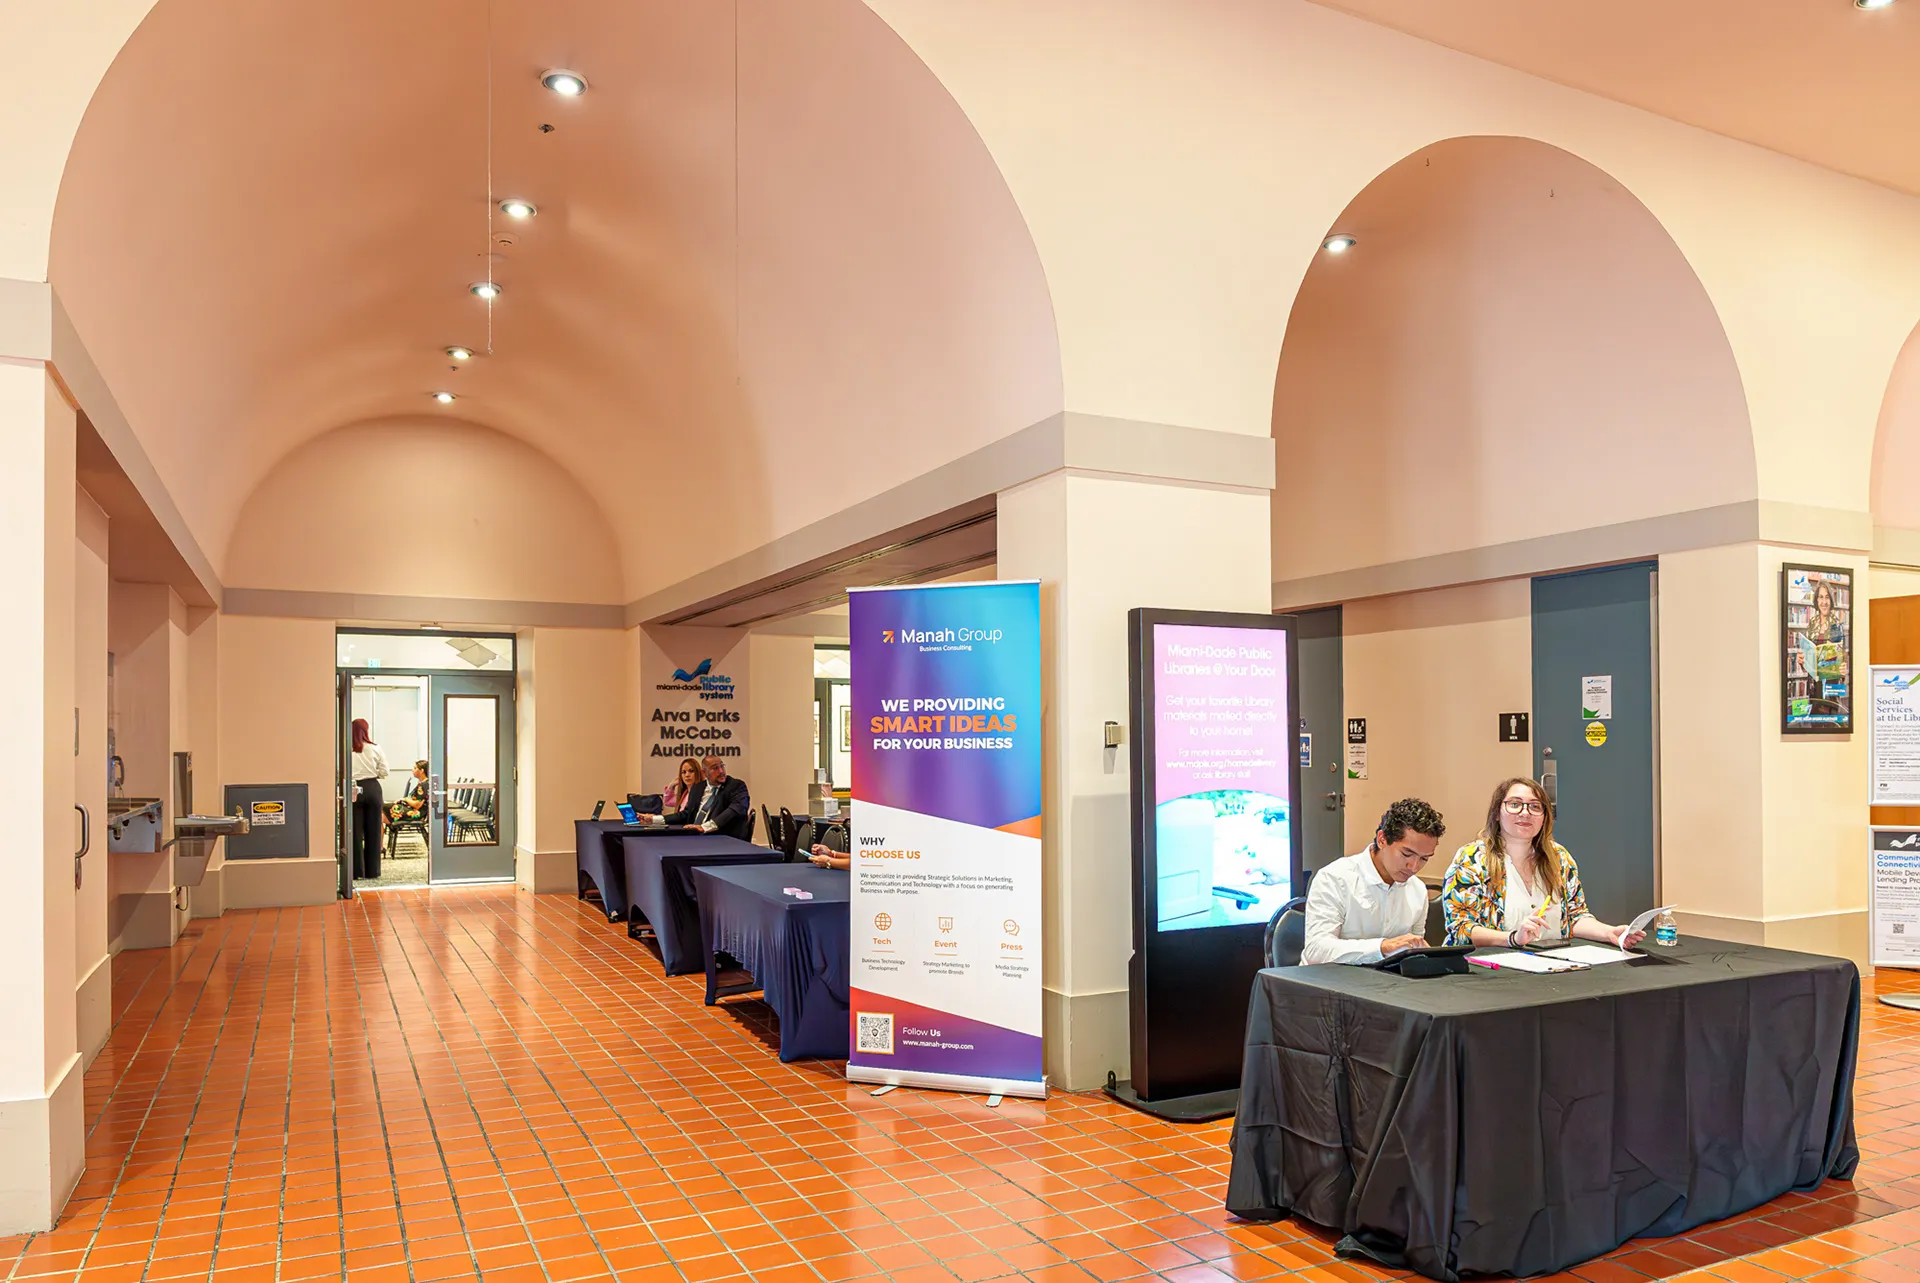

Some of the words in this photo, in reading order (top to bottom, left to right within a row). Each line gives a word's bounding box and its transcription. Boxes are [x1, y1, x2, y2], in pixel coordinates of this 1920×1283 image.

[902, 628, 954, 644] Manah
[958, 628, 1002, 644] Group
[1168, 644, 1236, 658] Miami-Dade
[1239, 647, 1272, 660] Public
[1164, 662, 1210, 676] Libraries
[1213, 664, 1222, 676] @
[1224, 664, 1248, 676] Your
[1250, 664, 1276, 676] Door
[700, 675, 731, 684] public
[702, 684, 735, 692] library
[700, 692, 733, 700] system
[1166, 695, 1184, 706] Get
[1186, 697, 1206, 708] your
[1209, 695, 1242, 706] favorite
[1244, 695, 1275, 708] Library
[881, 699, 909, 712] WE
[914, 697, 1005, 711] PROVIDING
[652, 708, 690, 722] Arva
[696, 709, 740, 722] Parks
[1164, 710, 1207, 721] materials
[1210, 711, 1241, 721] mailed
[1244, 711, 1277, 722] directly
[870, 715, 945, 733] SMART
[950, 714, 1017, 733] IDEAS
[660, 726, 732, 739] McCabe
[1190, 726, 1198, 736] to
[1201, 727, 1220, 738] your
[874, 739, 901, 750] FOR
[902, 738, 941, 750] YOUR
[944, 738, 1013, 749] BUSINESS
[650, 744, 741, 757] Auditorium
[860, 837, 885, 846] WHY
[860, 850, 904, 859] CHOOSE
[906, 851, 921, 859] US
[902, 1027, 928, 1036] Follow
[930, 1029, 941, 1037] Us
[902, 1039, 974, 1050] www.manah-group.com
